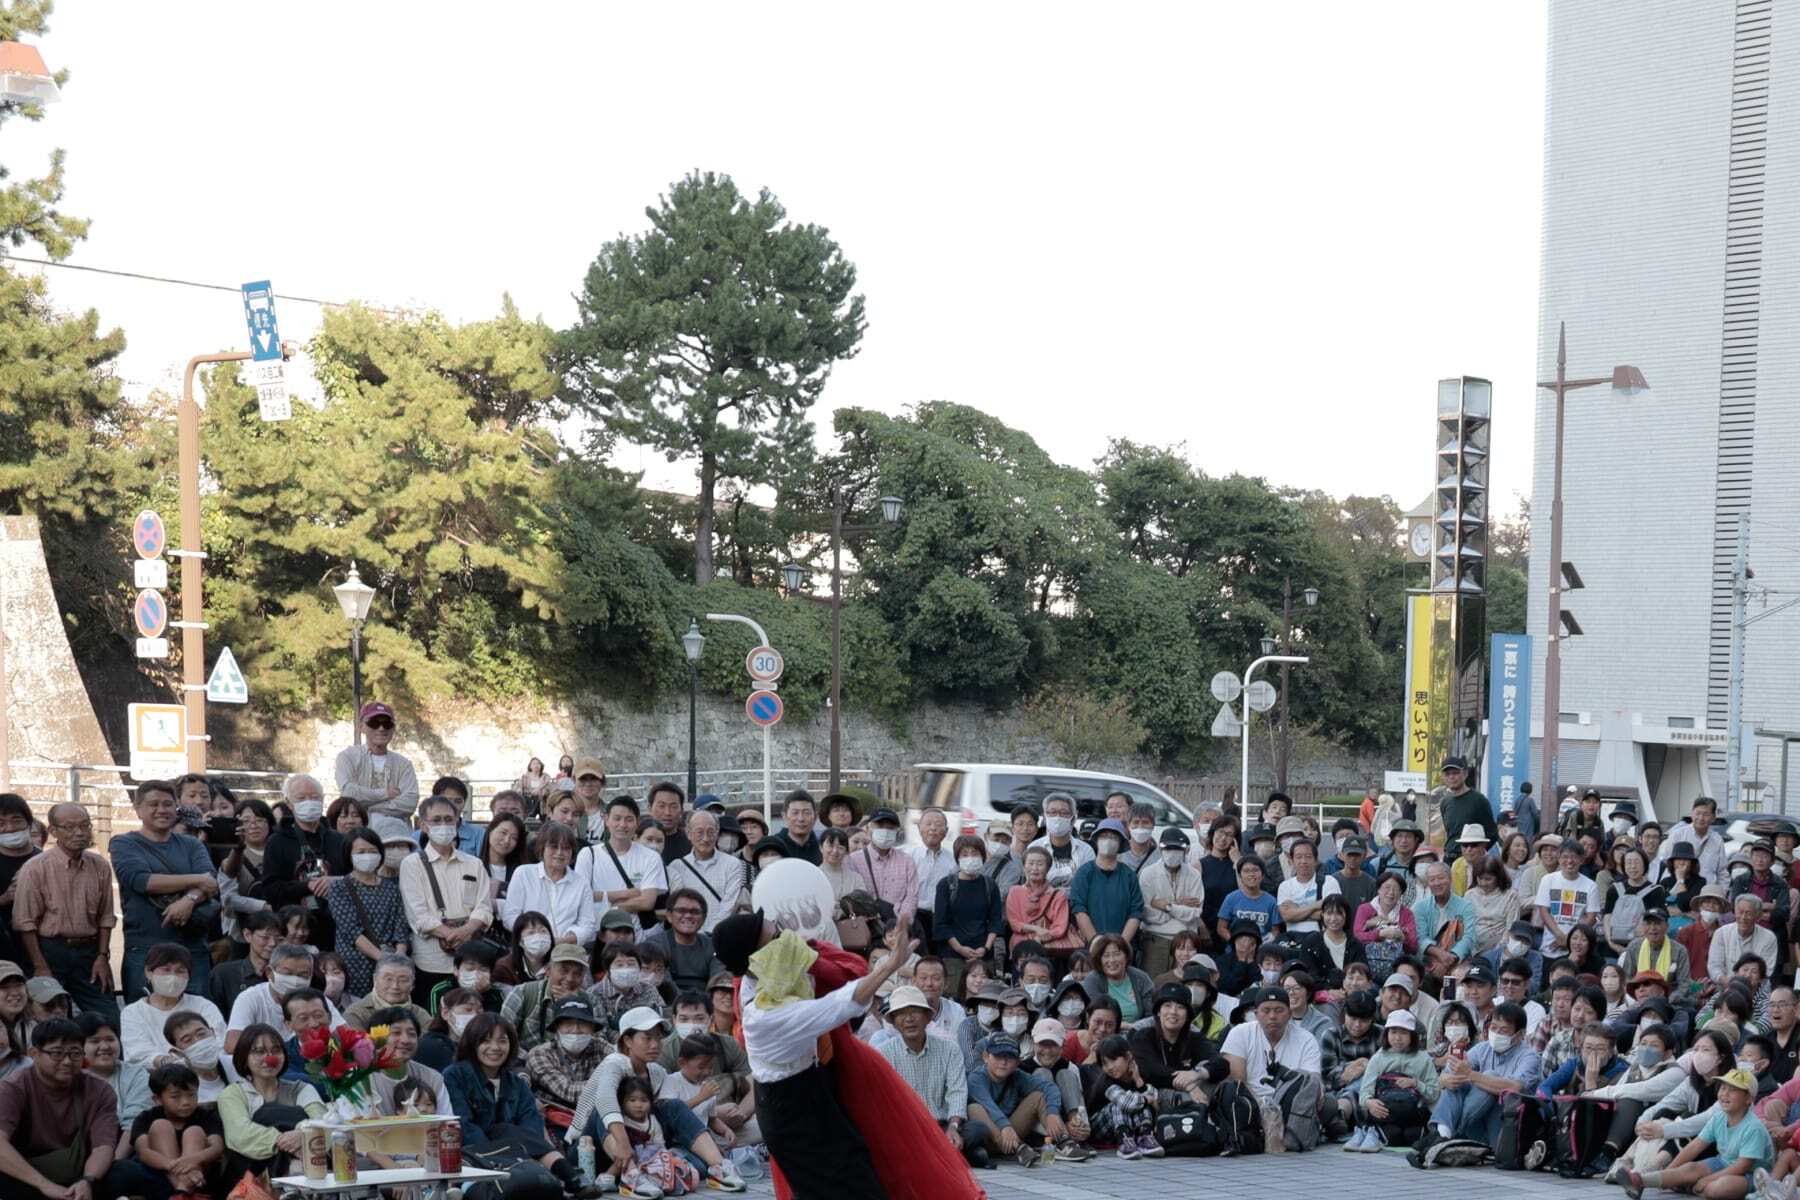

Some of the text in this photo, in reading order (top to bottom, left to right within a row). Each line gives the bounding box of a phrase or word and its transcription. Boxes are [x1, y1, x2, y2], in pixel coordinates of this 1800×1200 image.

[756, 656, 776, 672] 30
[1503, 643, 1519, 679] 一票に
[1413, 691, 1429, 763] 思いやり
